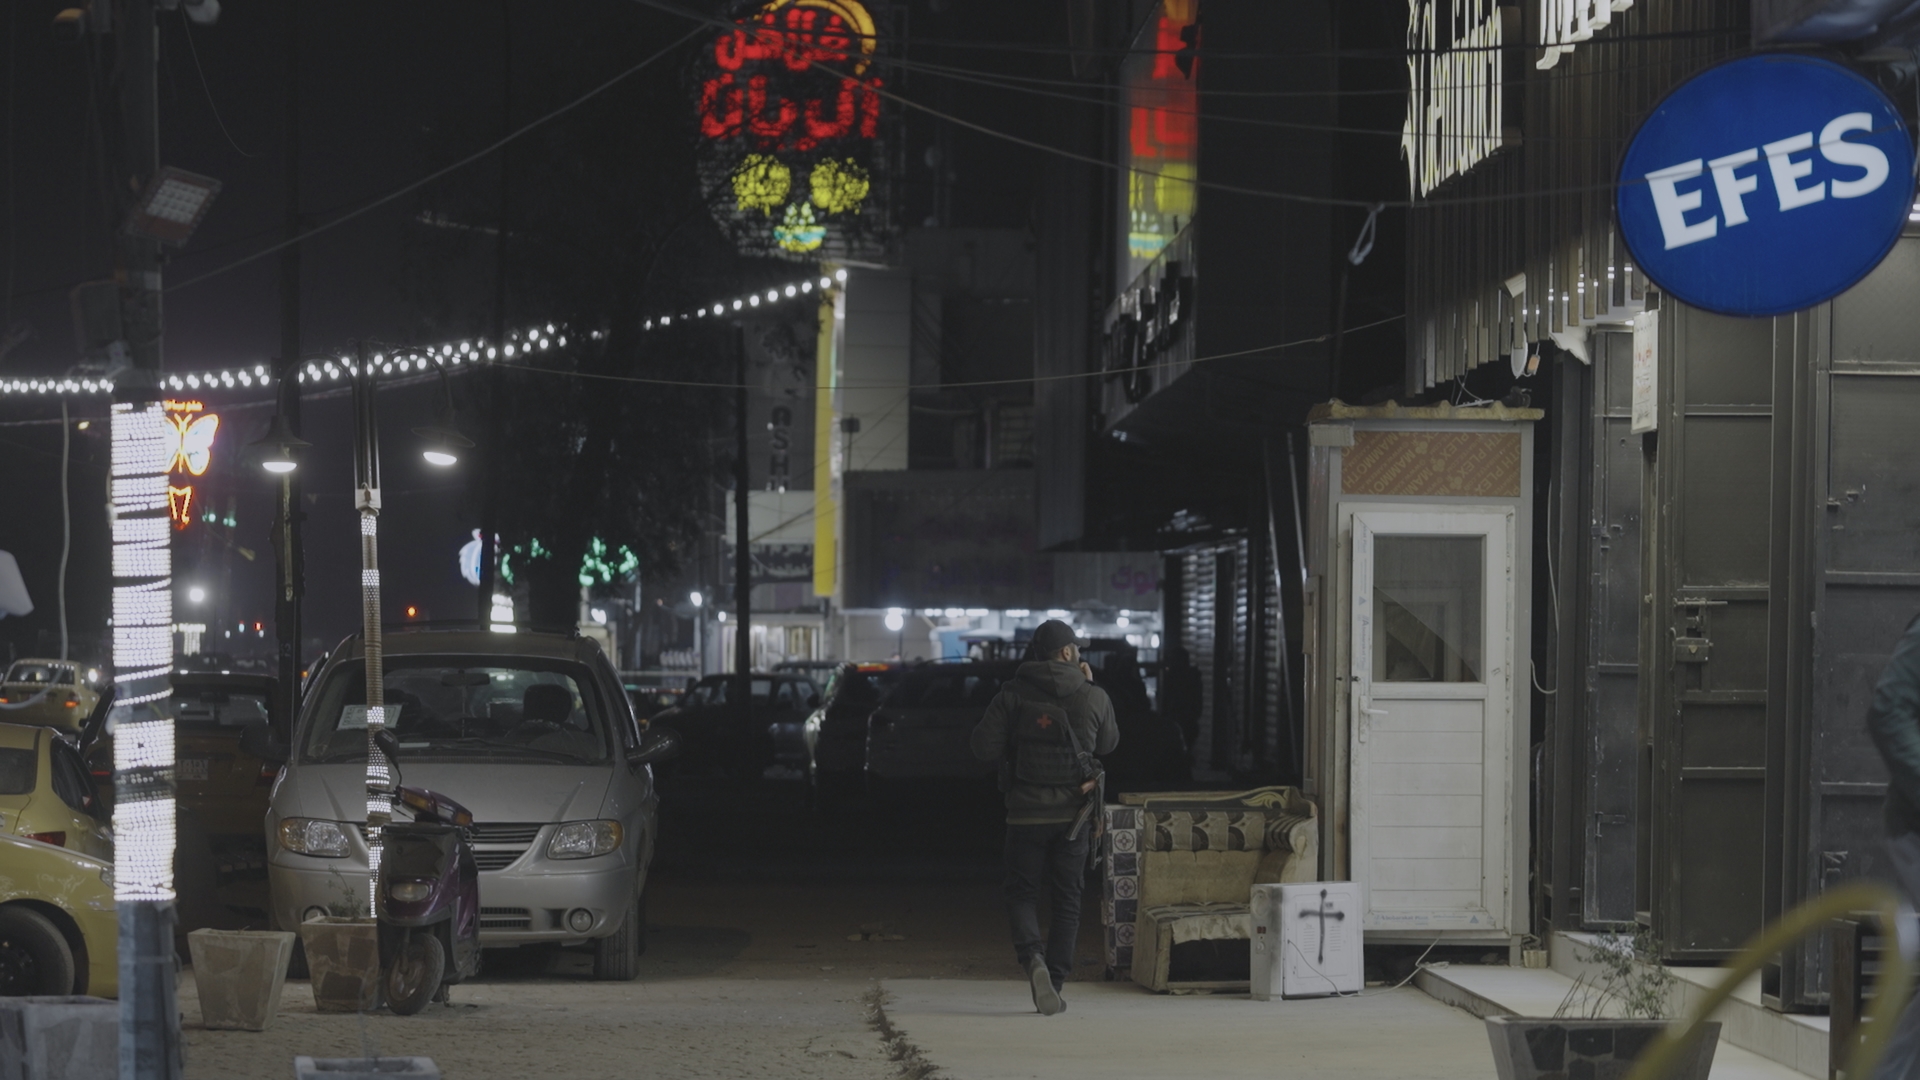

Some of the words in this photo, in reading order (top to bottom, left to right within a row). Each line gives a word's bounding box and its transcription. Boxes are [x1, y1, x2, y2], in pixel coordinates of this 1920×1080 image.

[1420, 0, 1502, 198] Glenfiddich
[1644, 112, 1890, 251] EFES
[1456, 447, 1487, 478] PLEX
[1473, 464, 1504, 496] PLEX
